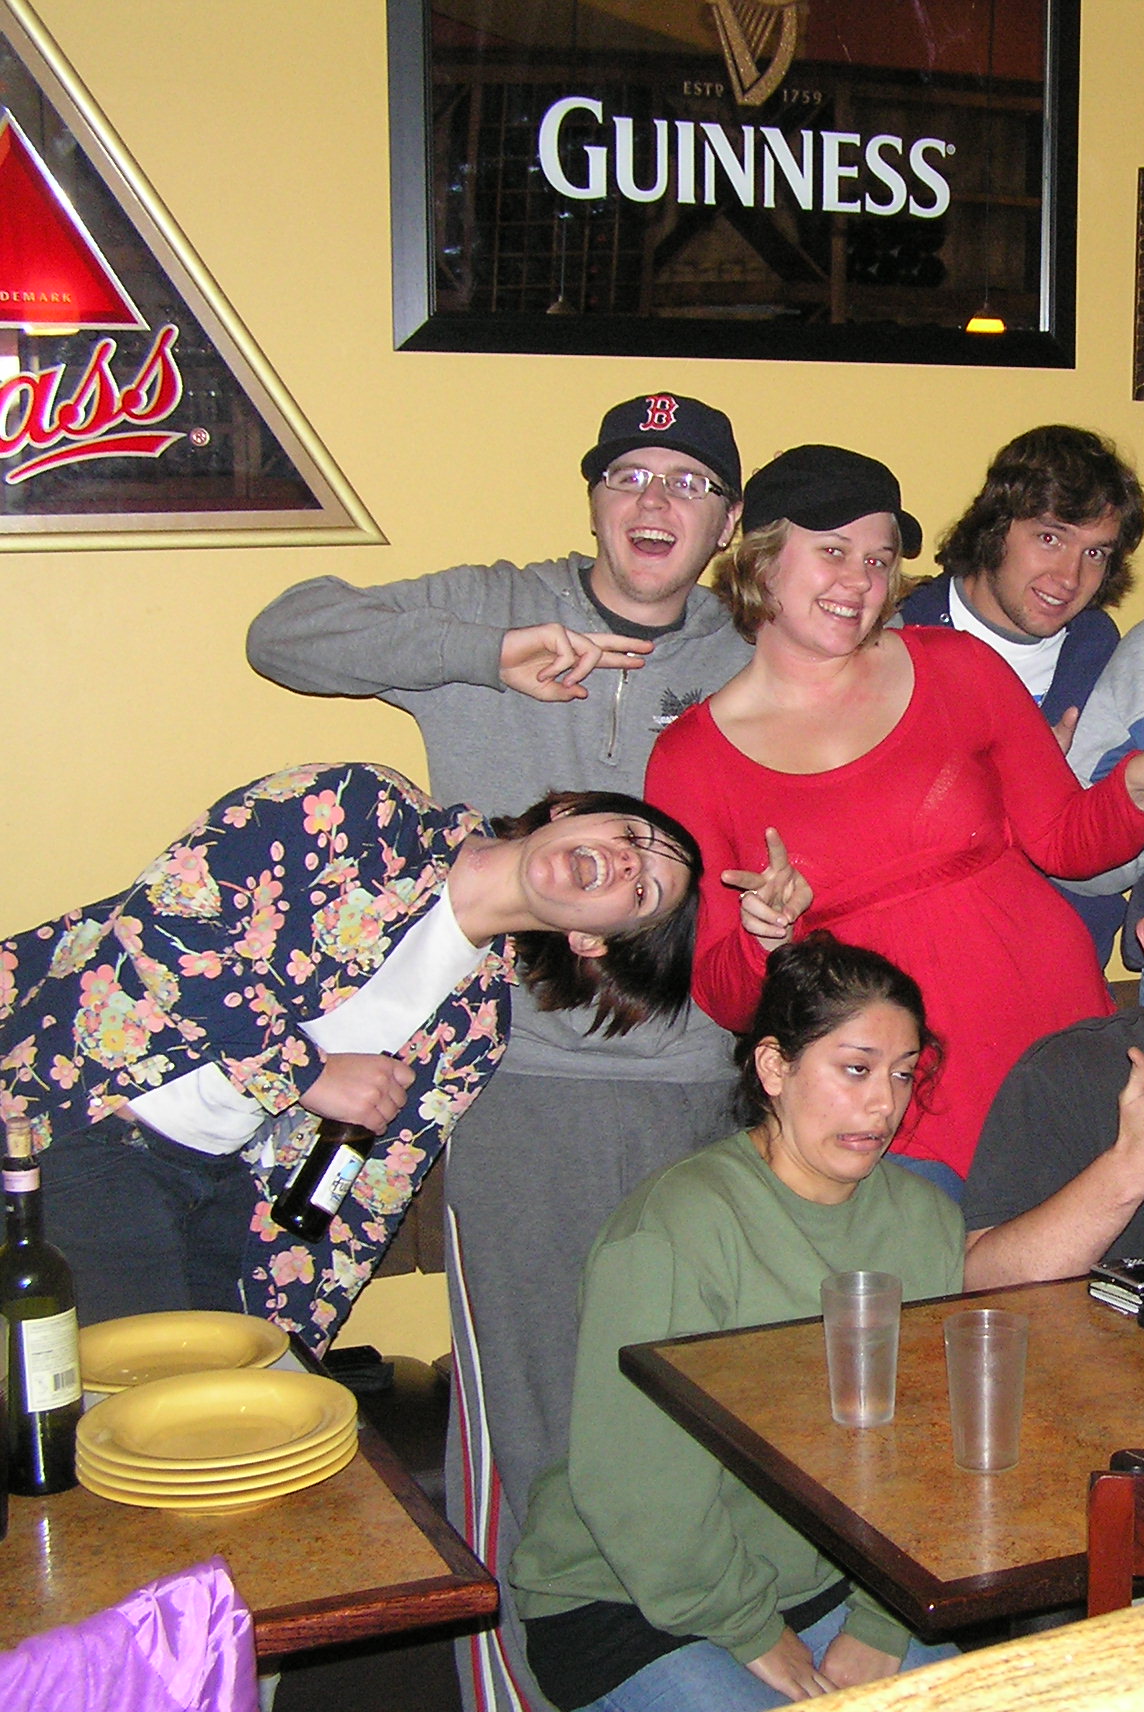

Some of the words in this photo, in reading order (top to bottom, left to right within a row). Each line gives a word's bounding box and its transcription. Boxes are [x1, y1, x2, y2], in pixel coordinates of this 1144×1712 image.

[783, 89, 823, 104] 1759
[538, 96, 951, 218] GUINNESS
[0, 290, 72, 303] DEMARK
[0, 324, 183, 458] ass
[639, 393, 679, 431] B
